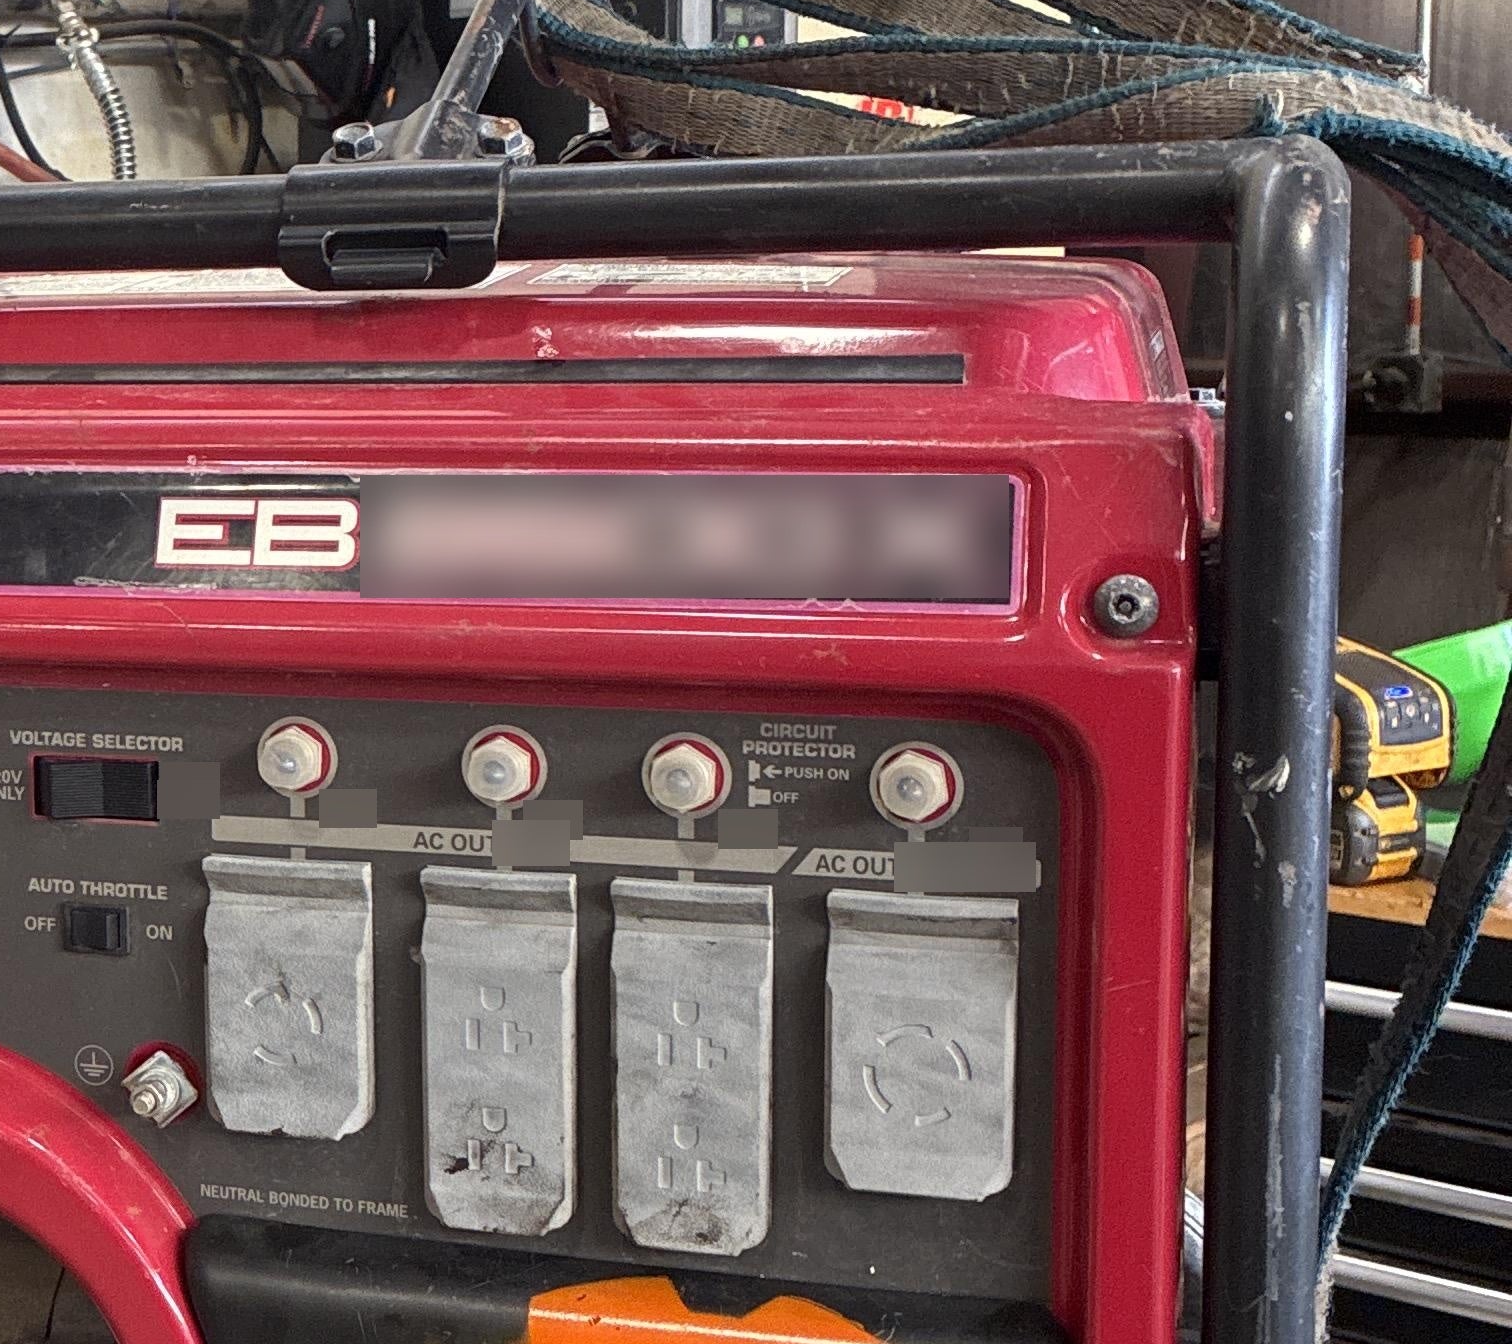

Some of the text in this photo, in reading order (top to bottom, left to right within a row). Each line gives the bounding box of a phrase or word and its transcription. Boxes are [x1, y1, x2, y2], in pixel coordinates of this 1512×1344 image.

[155, 498, 360, 569] EB
[9, 729, 184, 752] VOLTAGE SELECTOR
[760, 723, 837, 740] CIRCUIT
[742, 740, 856, 759] PROTECTOR
[784, 766, 849, 781] PUSH ON
[772, 791, 799, 804] OFF
[413, 831, 444, 851] AC
[815, 854, 839, 874] AC
[28, 877, 168, 900] AUTO THROTTLE
[24, 916, 57, 932] OFF
[146, 925, 173, 941] ON
[200, 1183, 408, 1219] NEUTRAL BONDED TO FRAME
